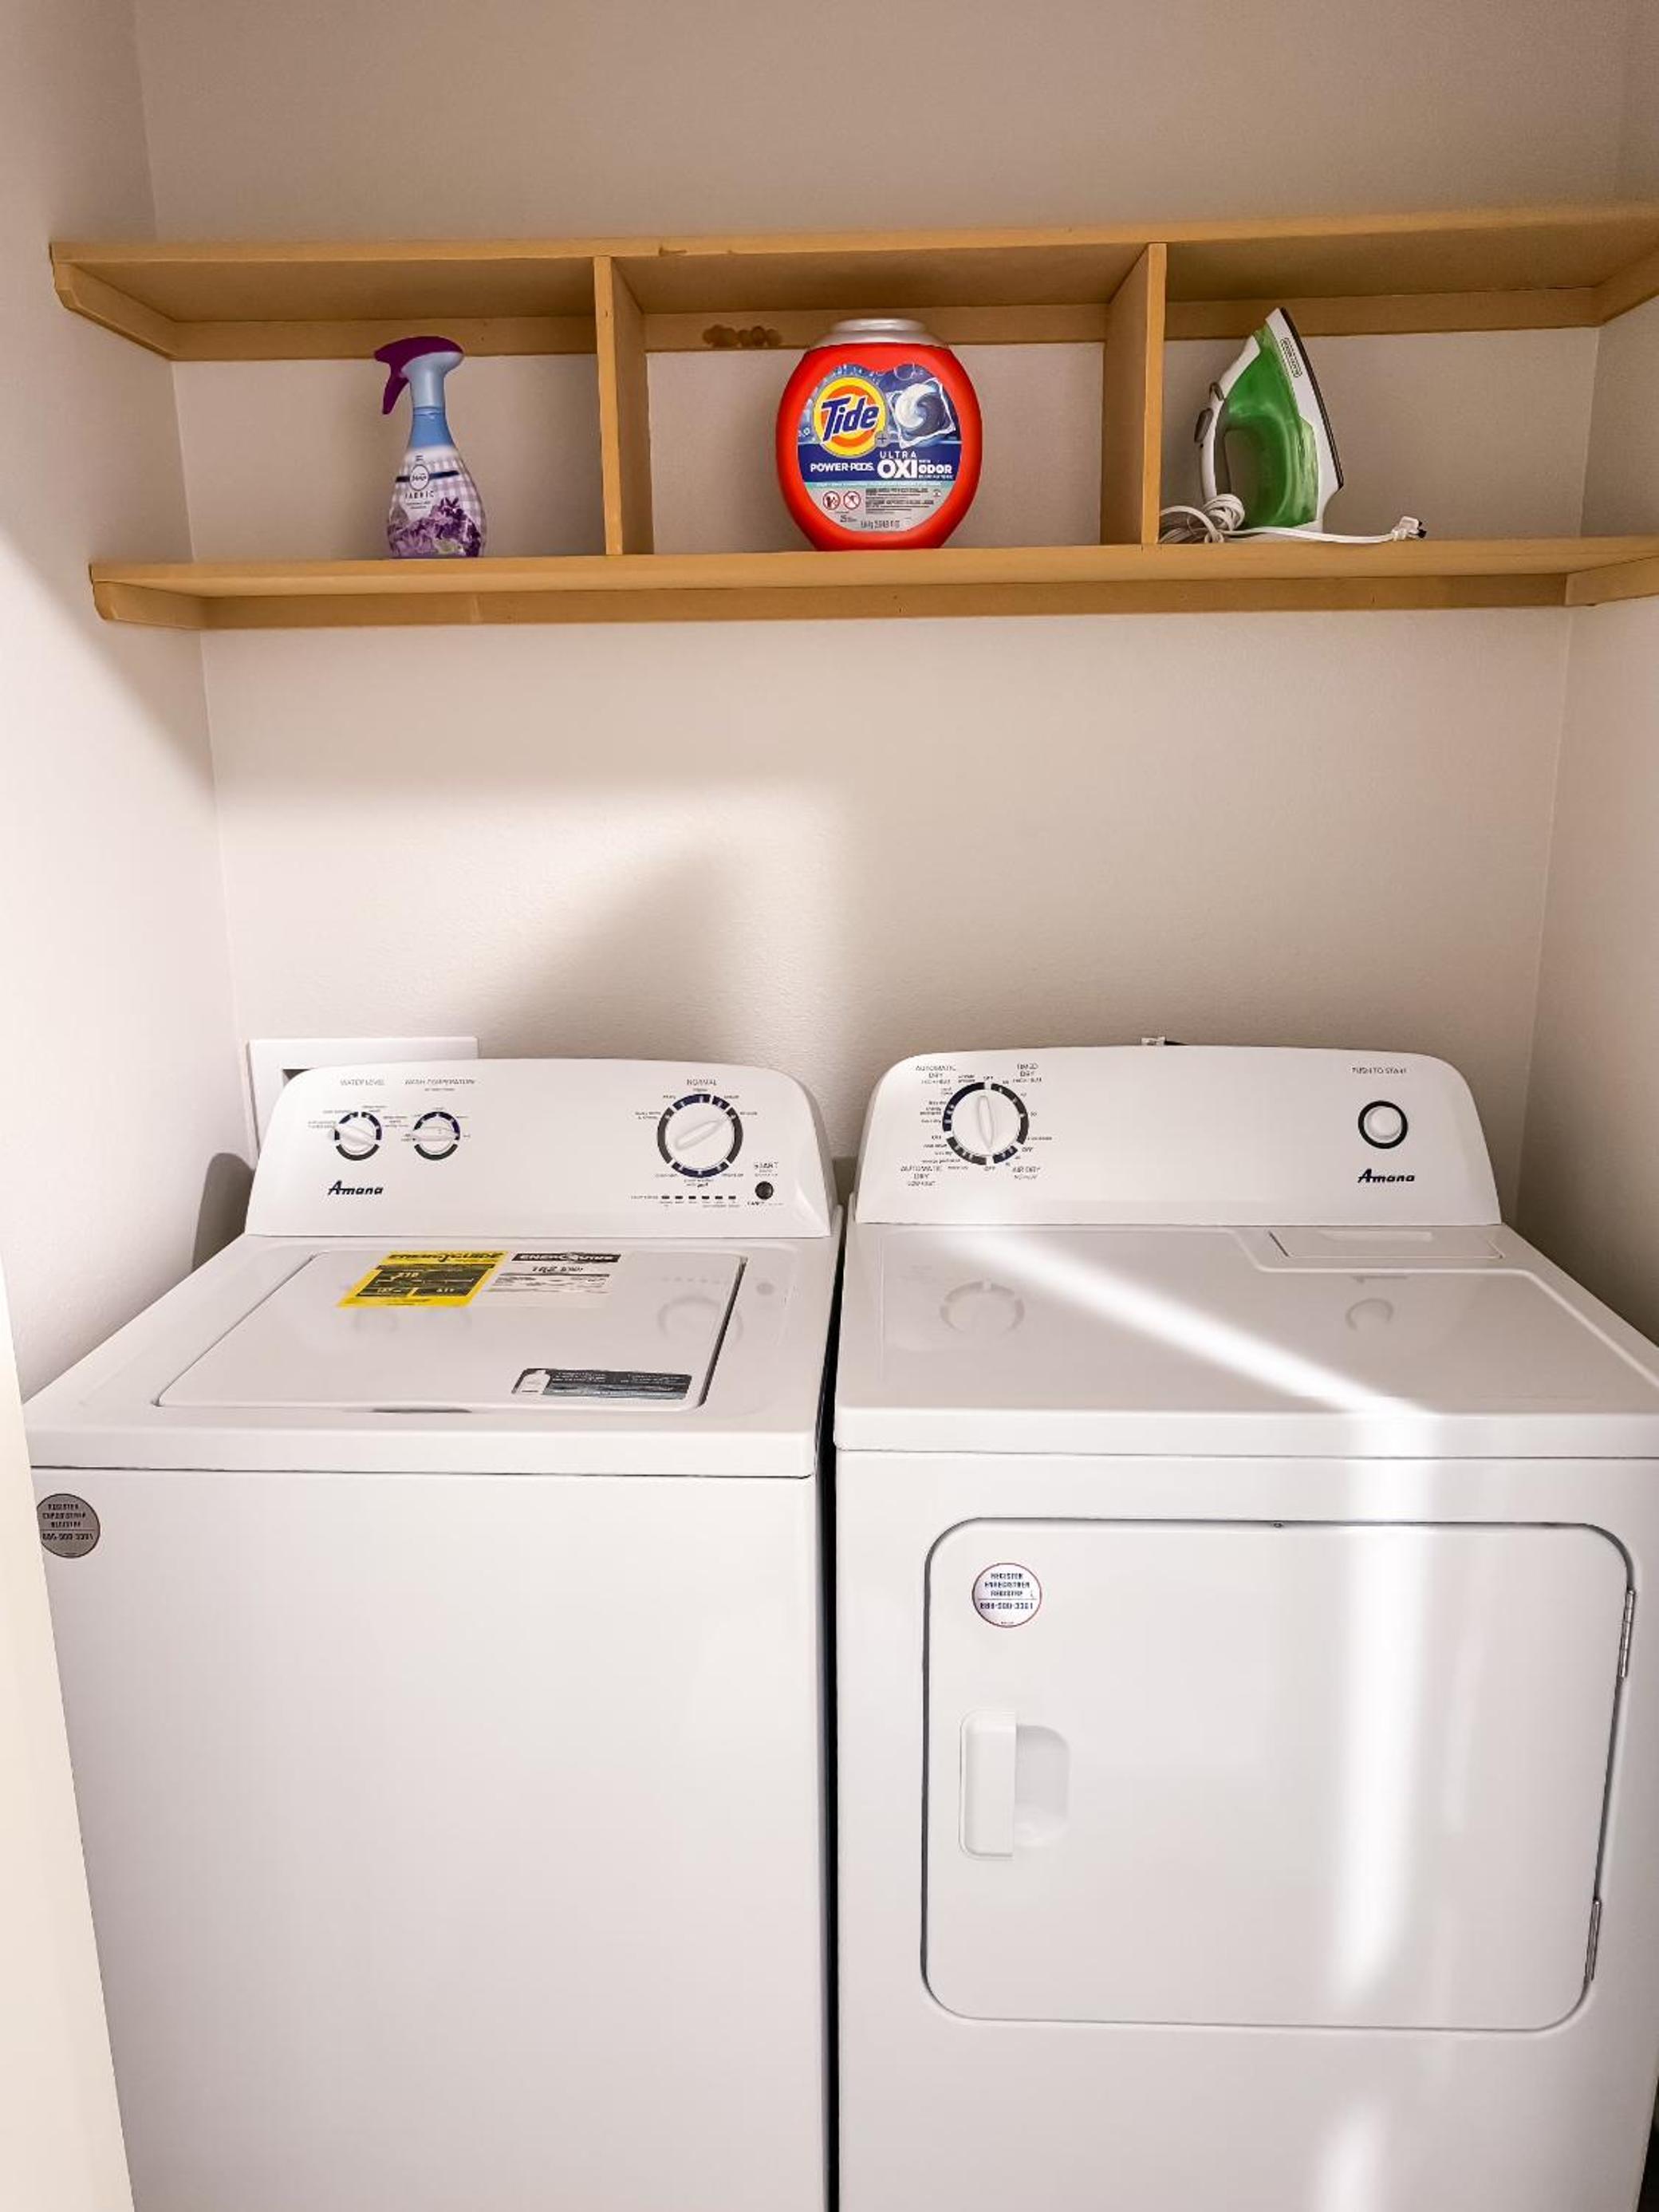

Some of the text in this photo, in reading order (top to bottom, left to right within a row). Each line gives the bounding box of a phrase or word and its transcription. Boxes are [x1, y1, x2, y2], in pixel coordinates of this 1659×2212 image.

[821, 395, 880, 444] Tide
[880, 451, 916, 459] ULTRA
[877, 459, 918, 479] OXI
[918, 464, 952, 474] ODOR
[1358, 1168, 1415, 1183] Amana
[328, 1180, 384, 1196] Amana
